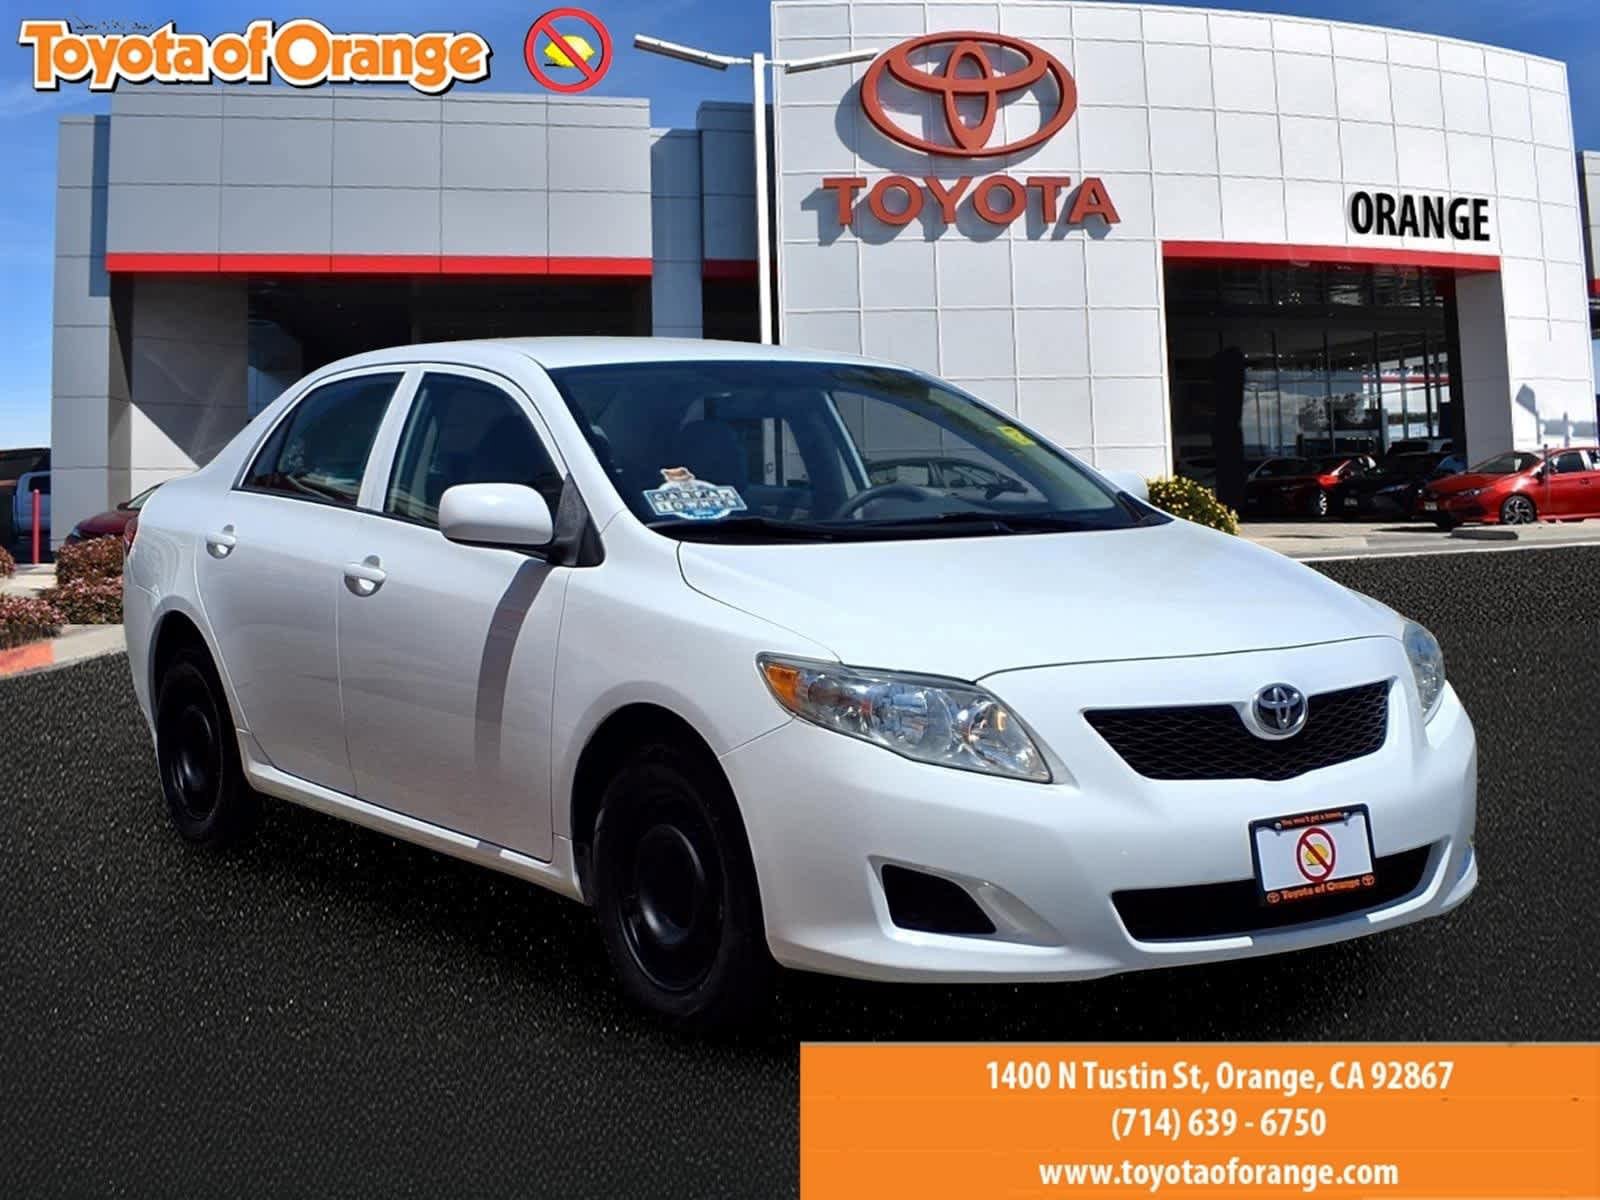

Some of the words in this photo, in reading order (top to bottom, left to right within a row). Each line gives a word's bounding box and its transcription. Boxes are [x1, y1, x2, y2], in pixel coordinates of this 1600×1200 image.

[822, 176, 1120, 224] TOYOTA
[1349, 191, 1491, 241] ORANGE
[1281, 886, 1314, 899] Toyota
[1314, 883, 1326, 893] of
[1326, 879, 1360, 891] Orange
